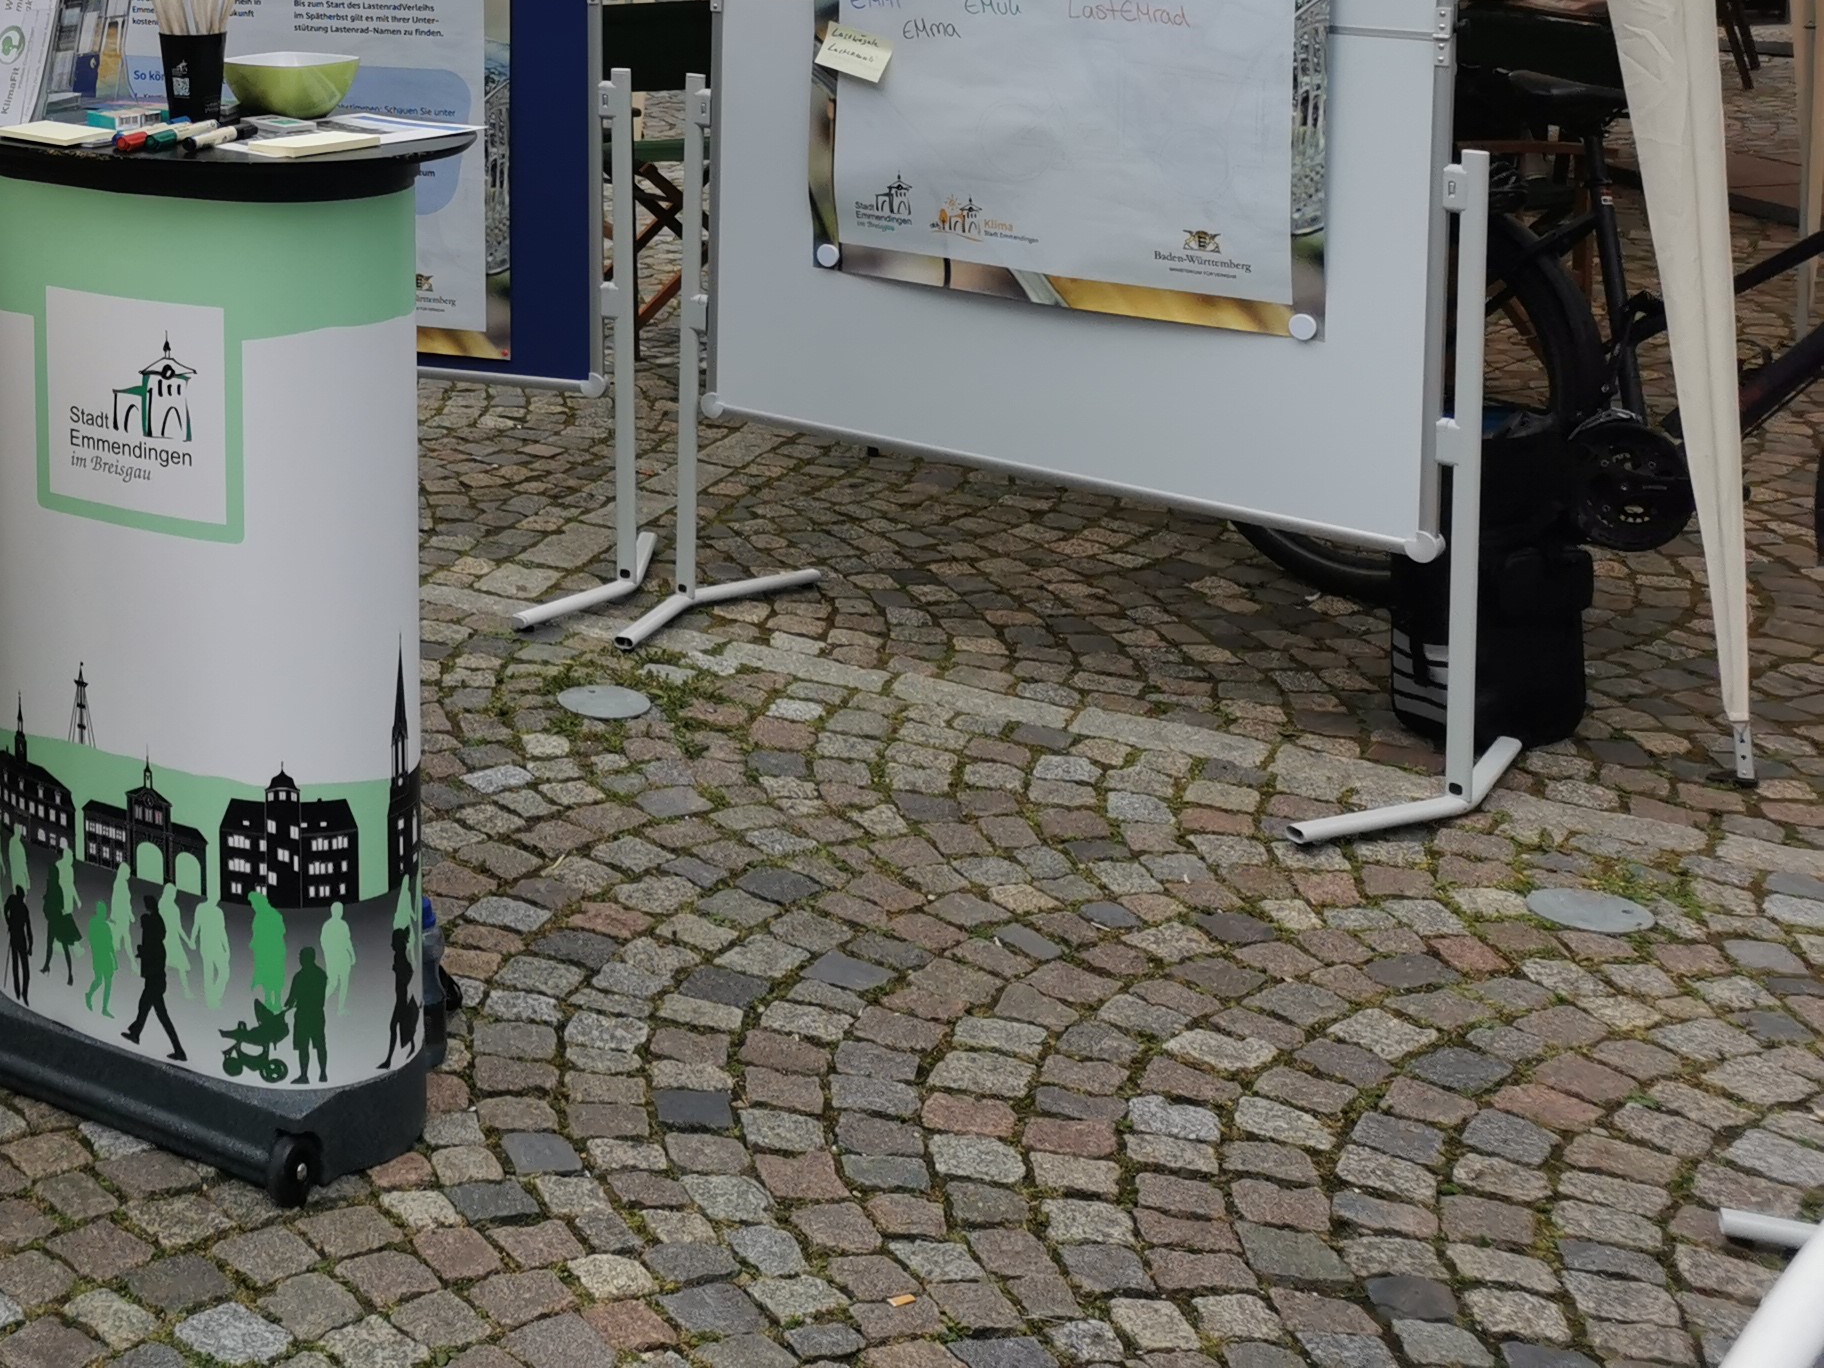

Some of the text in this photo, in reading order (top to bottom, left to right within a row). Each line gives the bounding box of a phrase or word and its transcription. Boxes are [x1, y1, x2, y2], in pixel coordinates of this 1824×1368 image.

[294, 0, 306, 8] Bis
[326, 1, 345, 9] Start
[347, 1, 361, 9] des
[362, 2, 435, 12] LastenradVerleihs
[294, 11, 440, 24] im Spätherbst mit Ihrer Unter-
[294, 24, 328, 34] stützung
[330, 25, 402, 36] Lastenrad-Namen
[414, 28, 444, 37] finden.
[133, 69, 146, 81] So
[1, 67, 20, 115] KlimaFit
[434, 108, 456, 117] unter
[854, 201, 874, 211] Stadt
[855, 210, 913, 226] Emmendingen
[984, 219, 1014, 232] Klima
[1153, 250, 1252, 273] Baden-Württemberg
[69, 405, 110, 430] Stadt
[69, 428, 193, 468] Emmendingen
[70, 450, 152, 483] im Breisgau
